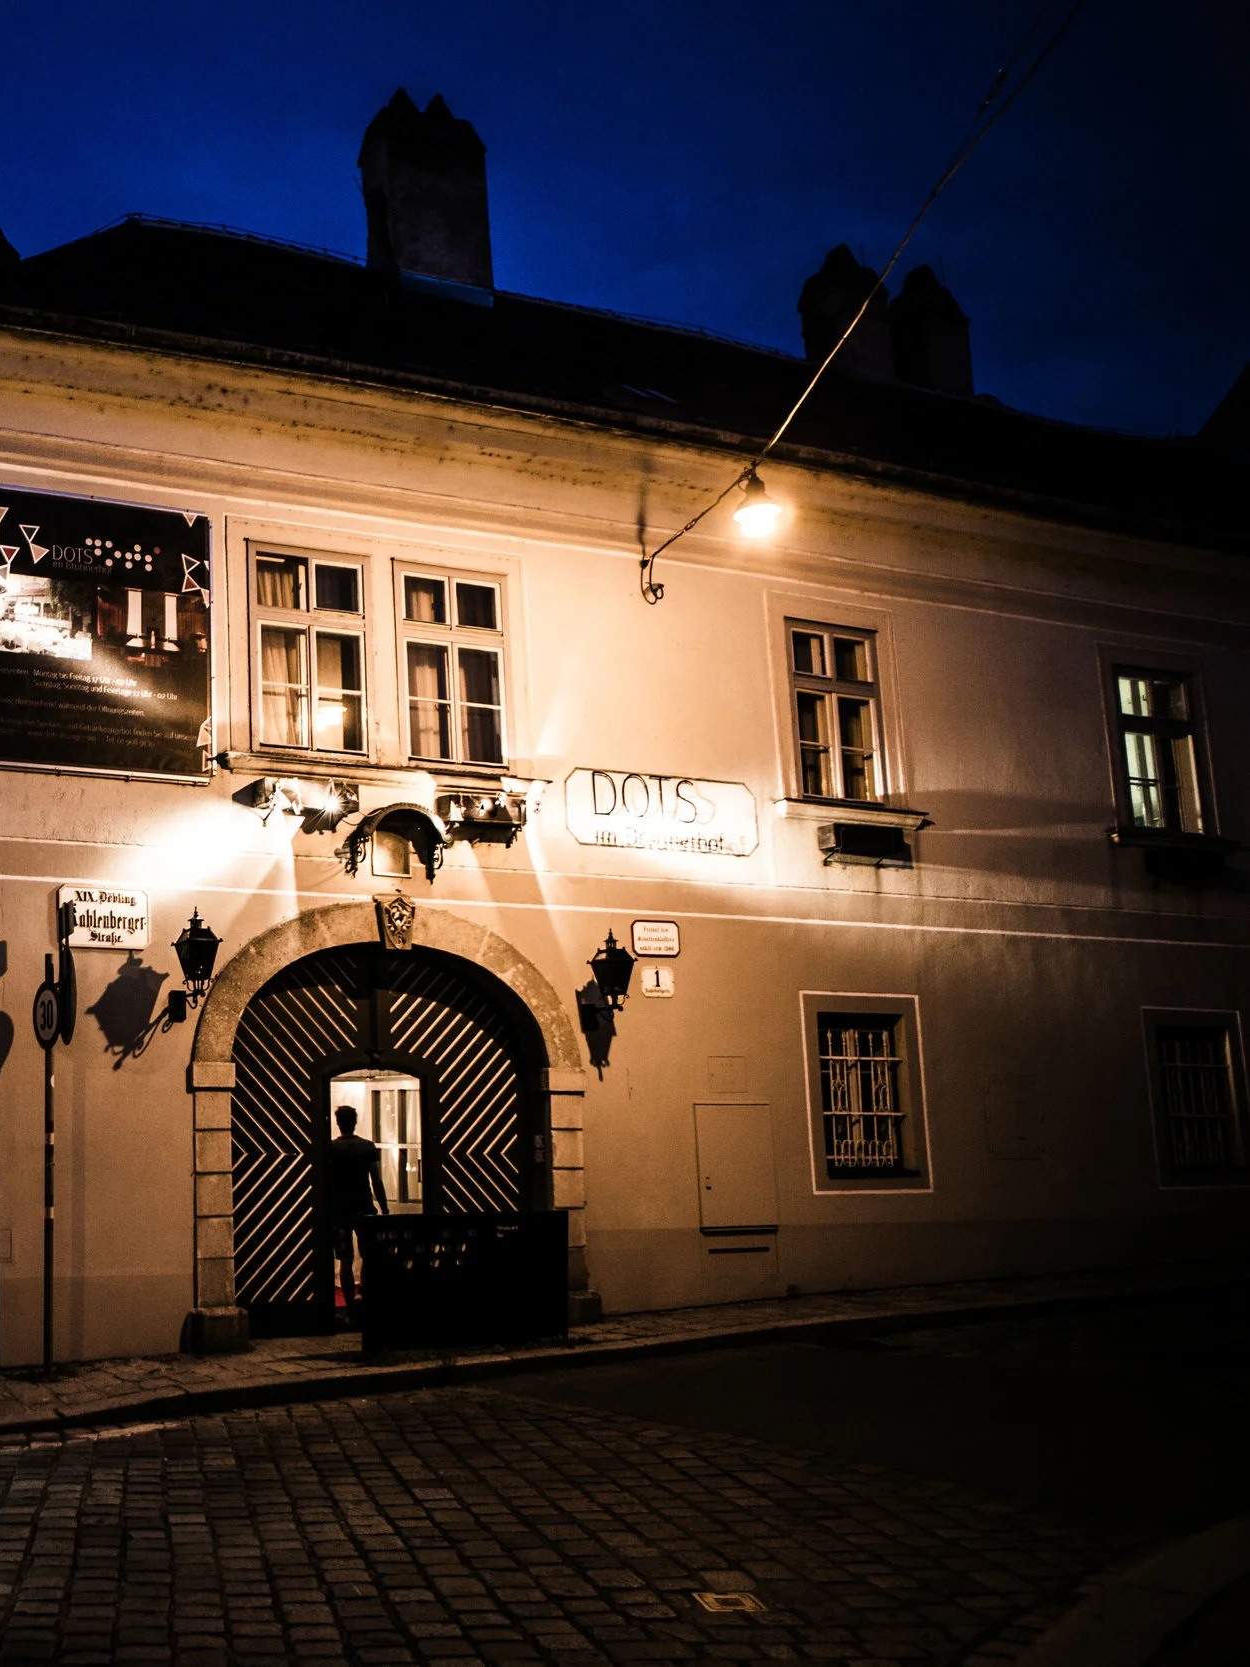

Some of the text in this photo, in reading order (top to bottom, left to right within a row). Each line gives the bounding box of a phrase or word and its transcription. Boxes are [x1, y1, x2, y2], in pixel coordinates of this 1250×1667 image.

[52, 544, 94, 565] DOTS
[33, 668, 58, 679] Montag
[58, 671, 69, 680] bis
[69, 672, 91, 684] Freitag
[99, 675, 112, 685] Uhr
[125, 677, 138, 687] Uhr
[90, 684, 103, 692] und
[103, 685, 133, 697] Feiertage
[140, 690, 153, 698] Uhr
[166, 692, 179, 701] Uhr
[592, 770, 698, 824] DOTS
[654, 969, 661, 988] 1
[40, 999, 54, 1031] 30
